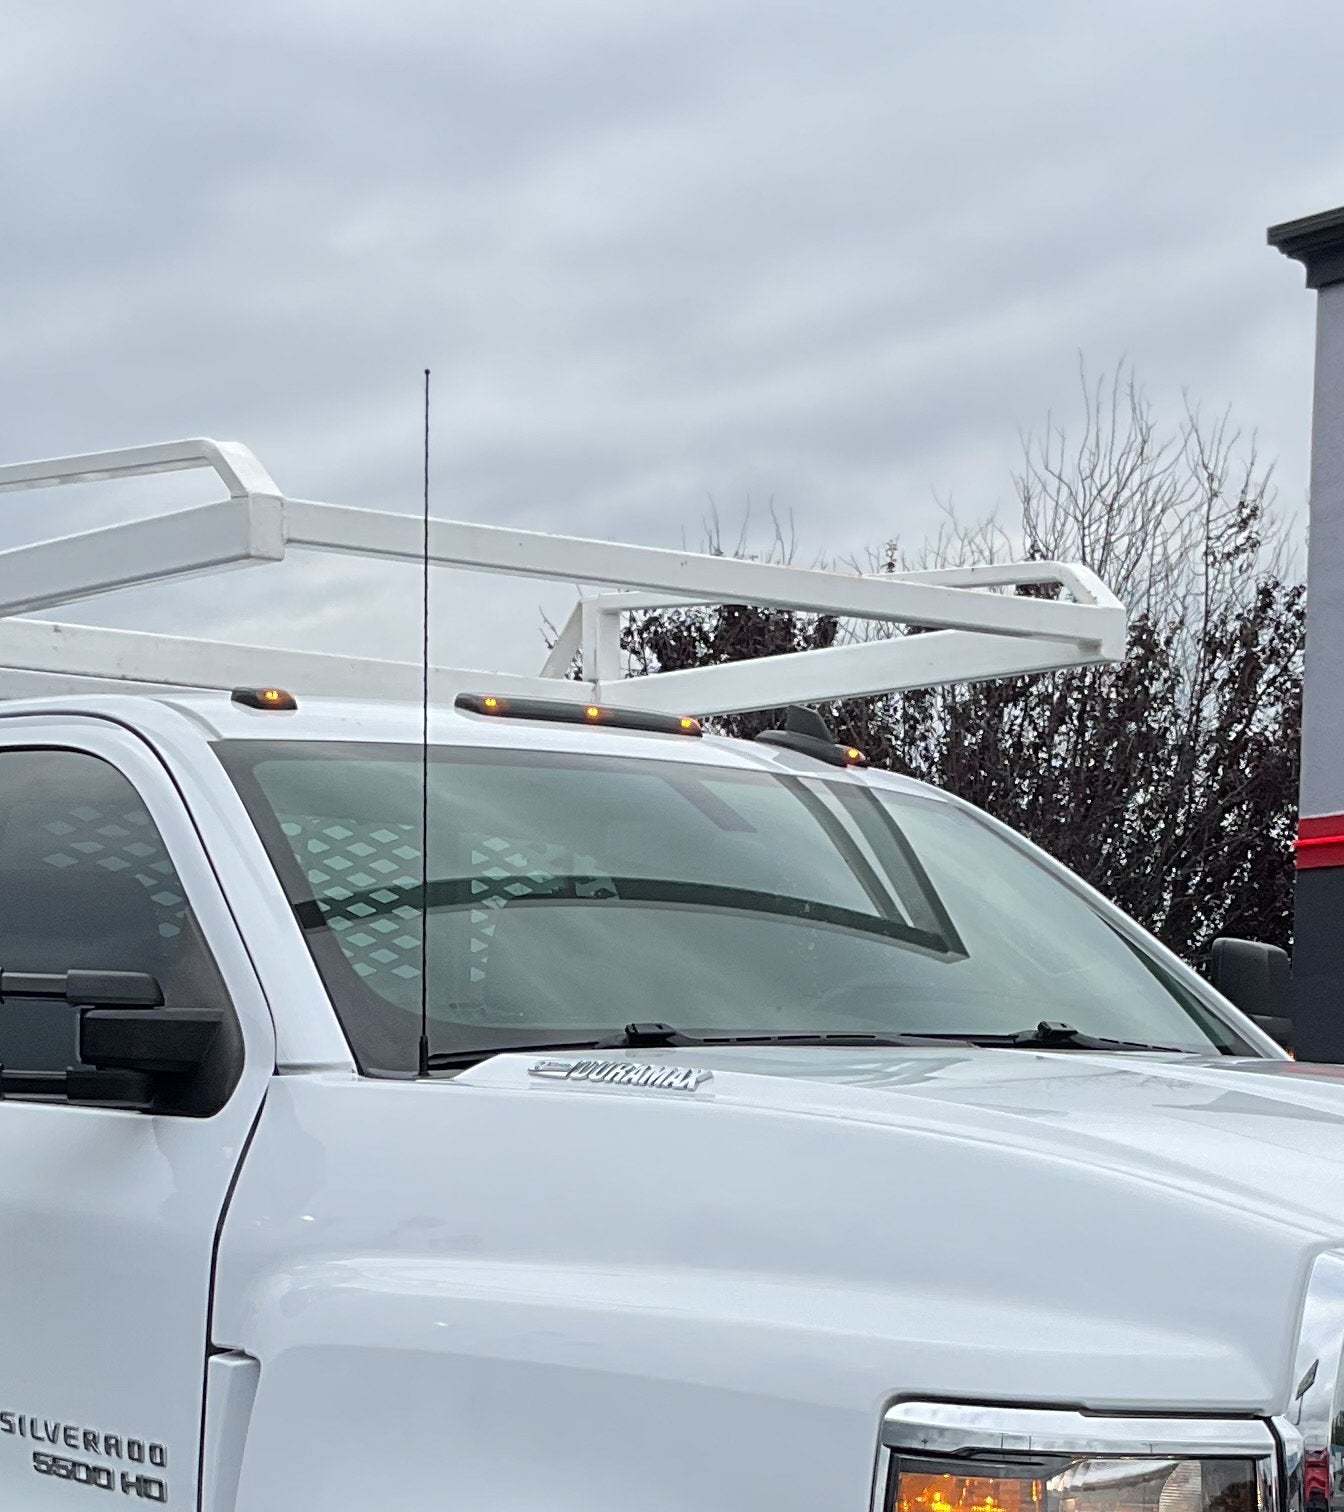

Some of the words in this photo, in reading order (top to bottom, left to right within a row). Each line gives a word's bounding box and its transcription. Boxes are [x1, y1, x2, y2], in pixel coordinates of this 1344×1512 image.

[567, 1060, 714, 1092] DURAMAX
[0, 1410, 168, 1468] SILVERADO
[32, 1450, 116, 1491] 5500
[119, 1470, 168, 1504] HD
